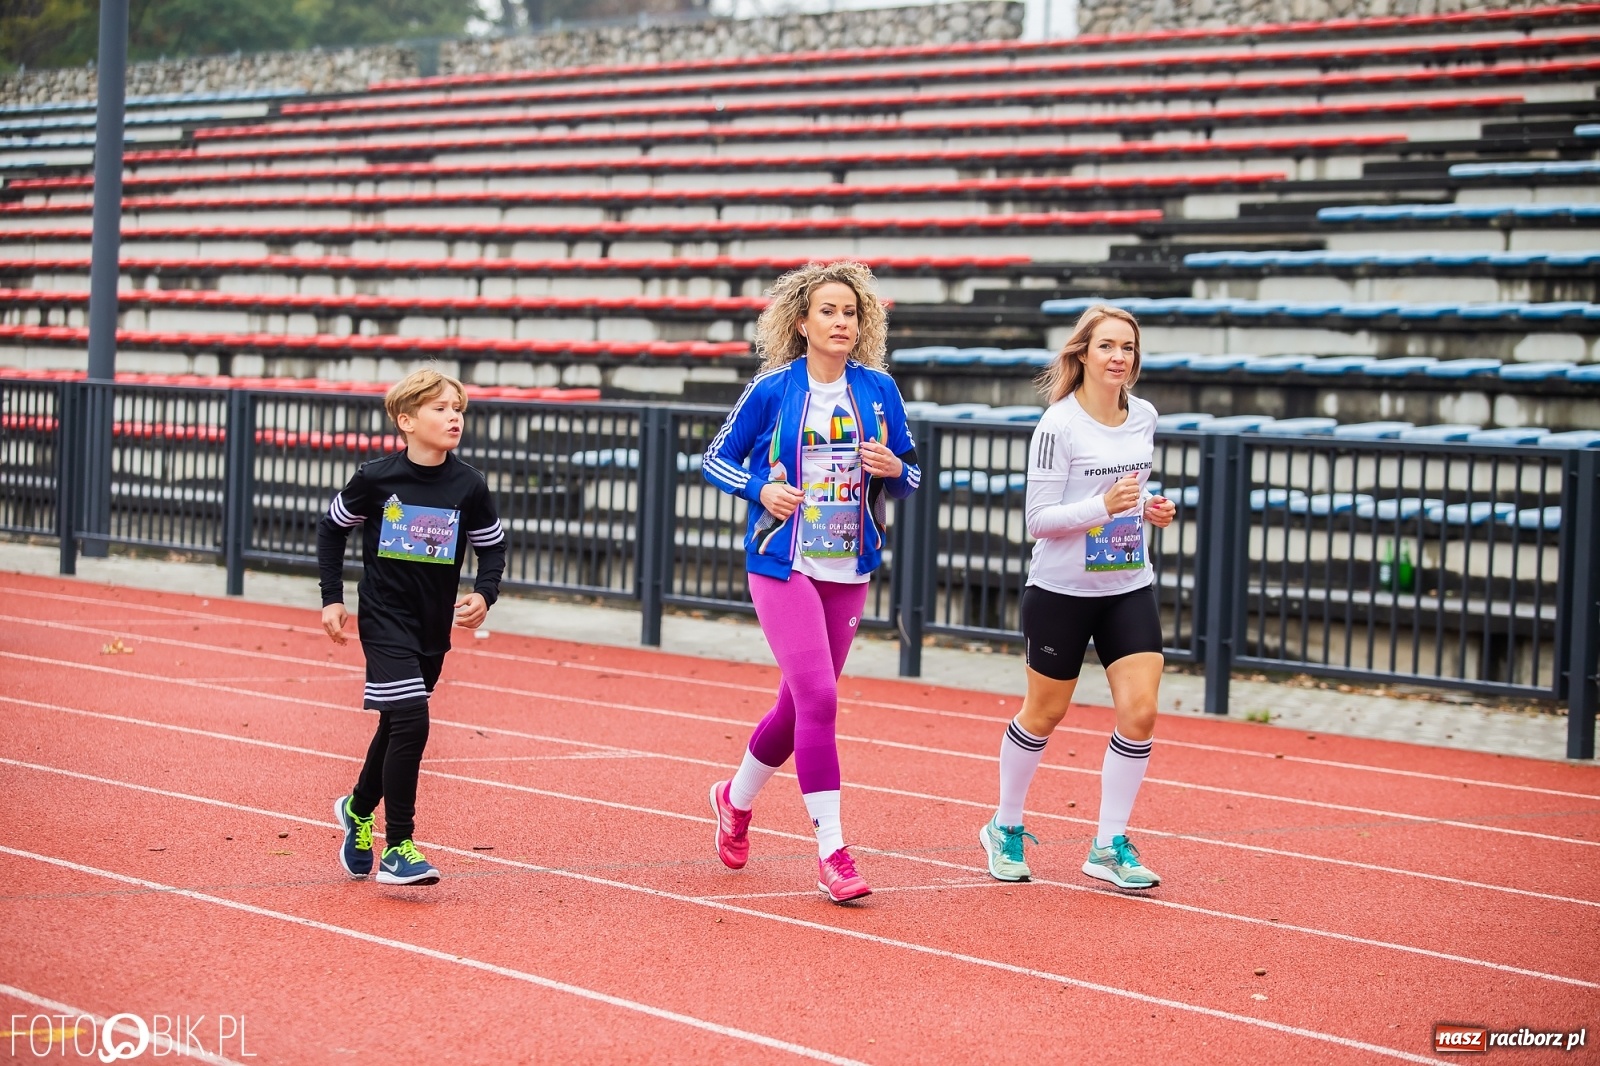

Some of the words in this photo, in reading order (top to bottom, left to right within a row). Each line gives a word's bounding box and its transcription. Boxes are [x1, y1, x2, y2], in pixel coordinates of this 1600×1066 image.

[392, 523, 407, 531] BIEG
[410, 525, 424, 533] DLA
[1095, 536, 1108, 544] BIEG
[426, 545, 448, 558] 071
[1125, 551, 1140, 562] 012
